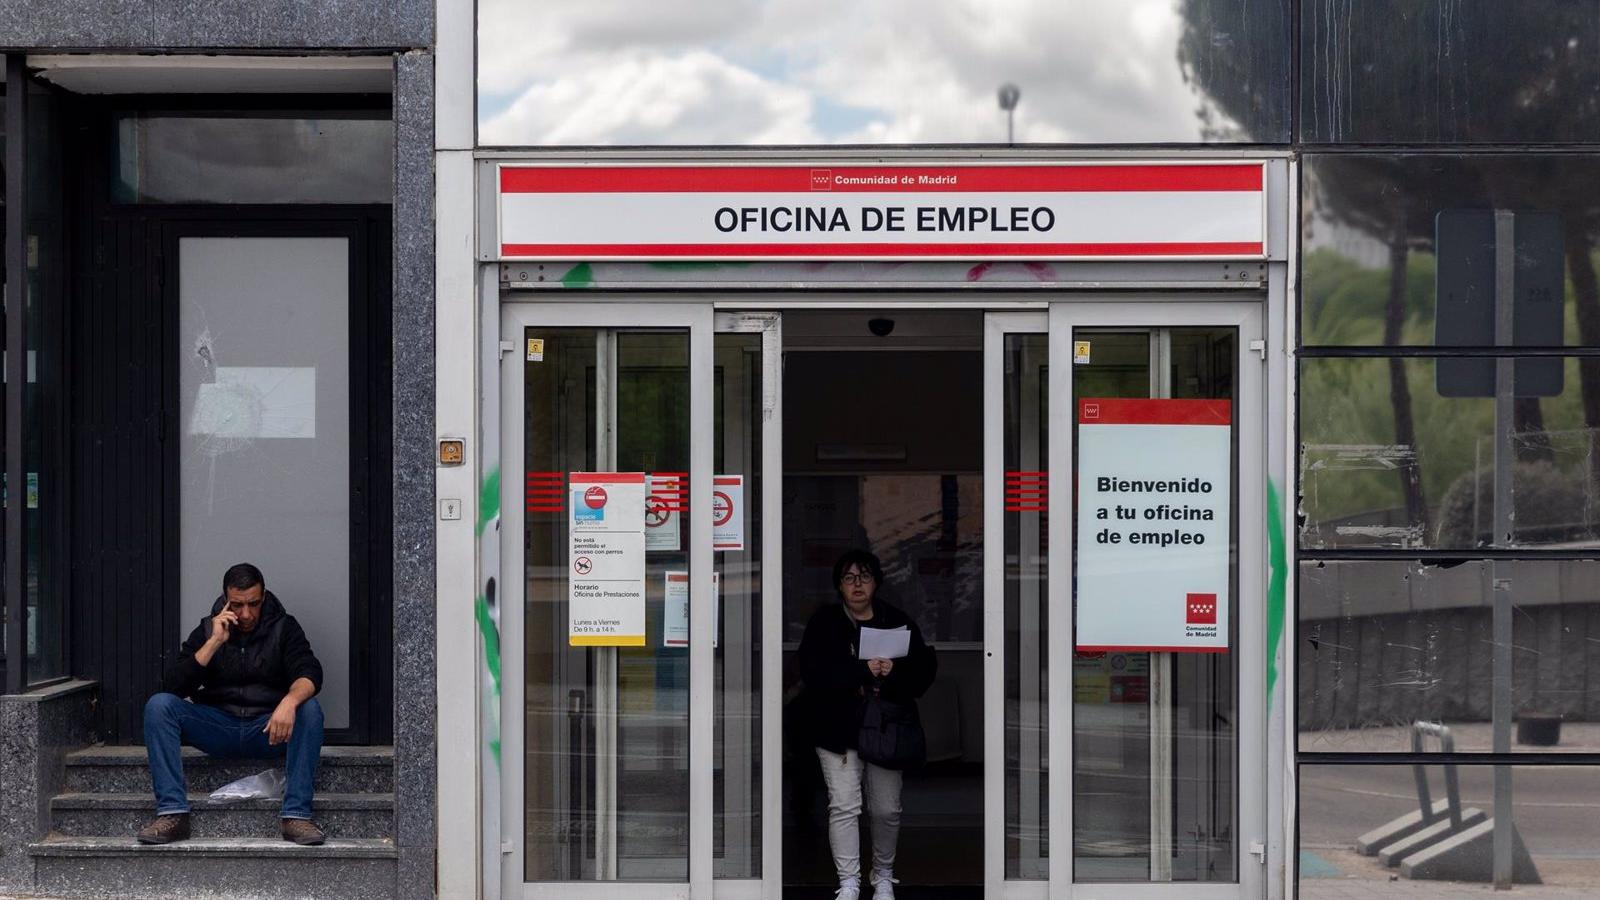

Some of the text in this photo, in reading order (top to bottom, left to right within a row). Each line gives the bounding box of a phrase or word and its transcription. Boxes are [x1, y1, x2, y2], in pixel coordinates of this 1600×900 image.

[834, 175, 957, 185] Comunidad de Madrid
[714, 206, 1056, 233] OFICINA DE EMPLEO
[1096, 476, 1213, 494] Bienvenido
[1096, 504, 1214, 521] a tu oficina
[1096, 528, 1206, 548] de empleo
